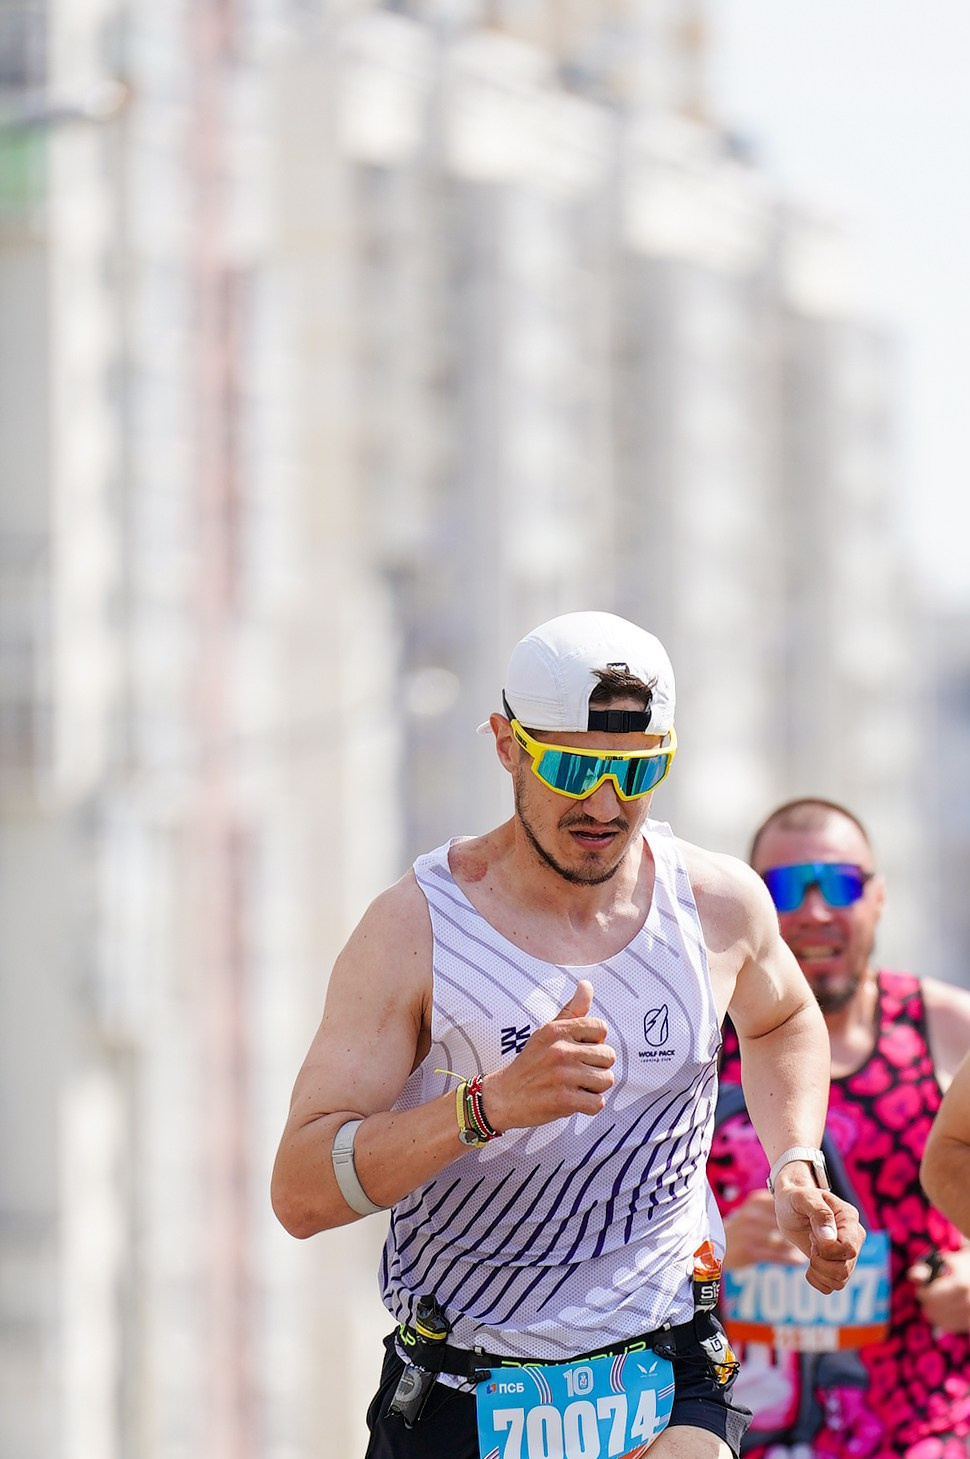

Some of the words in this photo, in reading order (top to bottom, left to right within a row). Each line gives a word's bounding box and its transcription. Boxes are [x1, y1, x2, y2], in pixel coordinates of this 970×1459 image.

[659, 1049, 676, 1057] PACK
[562, 1366, 595, 1397] 10
[498, 1382, 525, 1395] ПСБ
